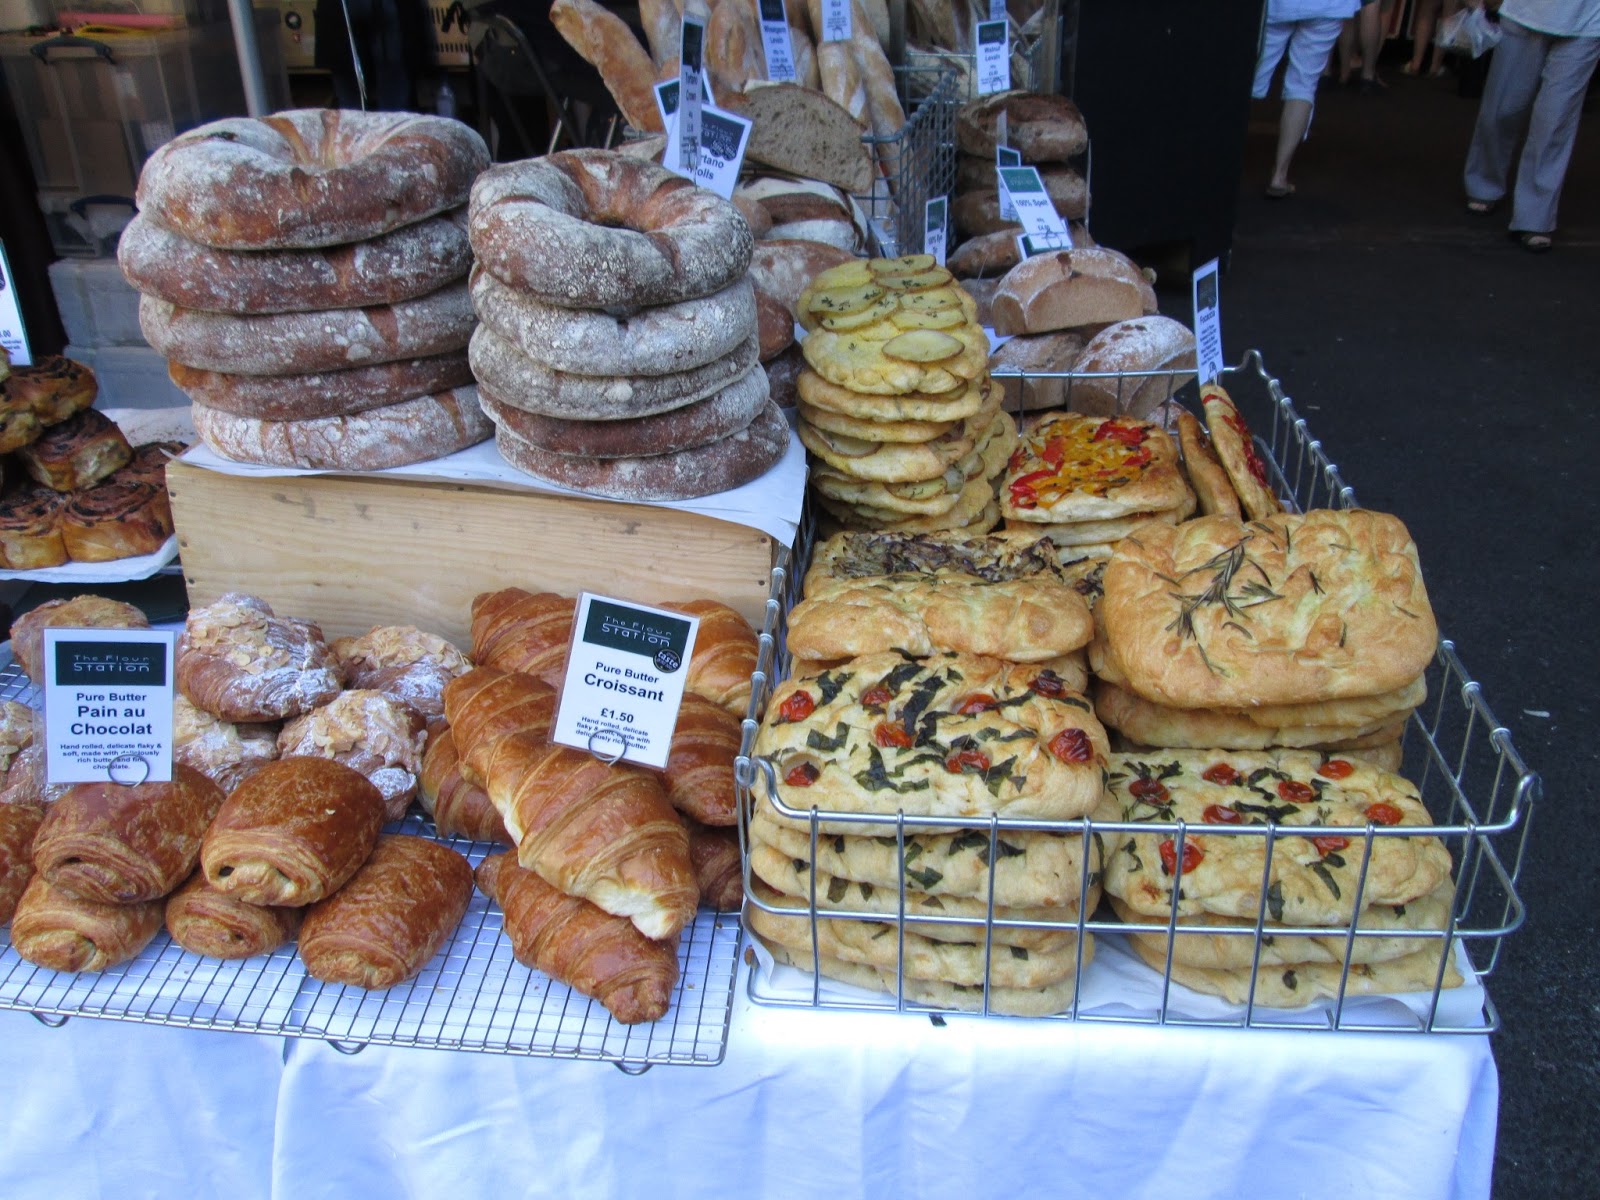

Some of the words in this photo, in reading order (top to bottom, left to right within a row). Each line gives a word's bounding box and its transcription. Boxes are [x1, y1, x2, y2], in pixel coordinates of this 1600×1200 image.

[605, 616, 626, 626] The
[632, 622, 672, 636] Flour
[601, 623, 670, 647] Station
[73, 654, 98, 662] The
[658, 651, 678, 668] taste
[73, 662, 150, 672] Station
[595, 662, 622, 676] Pure
[624, 666, 659, 684] Butter
[584, 673, 664, 702] Croissant
[76, 693, 105, 701] Pure
[109, 693, 147, 701] Butter
[77, 705, 117, 718] Pain
[124, 708, 145, 718] au
[600, 707, 634, 723] £1.50
[70, 723, 152, 735] Chocolat
[581, 716, 599, 725] Hand
[622, 726, 648, 736] delicate
[636, 736, 651, 744] with
